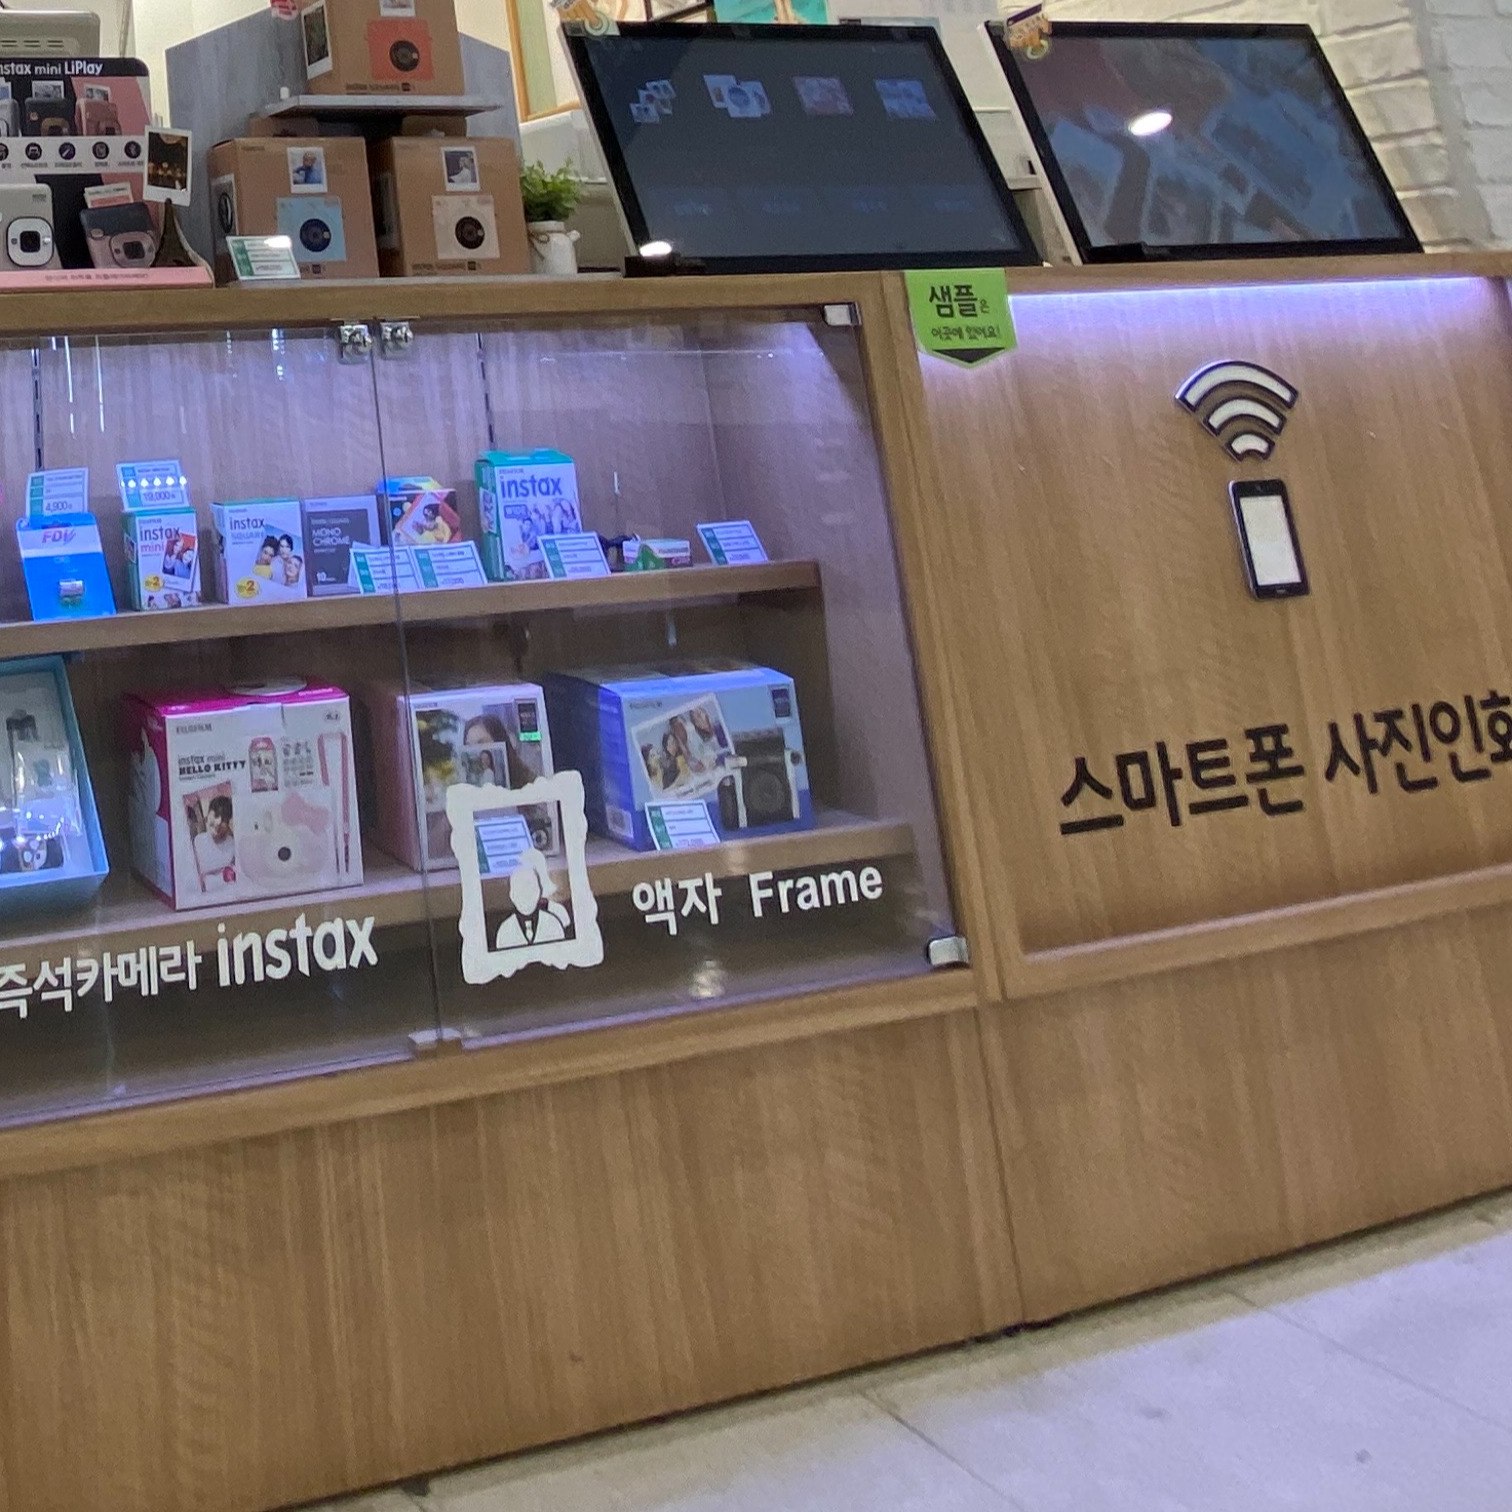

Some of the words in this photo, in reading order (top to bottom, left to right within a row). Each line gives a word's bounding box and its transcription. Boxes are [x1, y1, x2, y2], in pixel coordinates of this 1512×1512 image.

[34, 62, 62, 75] mini
[63, 61, 103, 76] LiPlay
[931, 325, 964, 341] 이곳에
[499, 475, 563, 499] instax
[229, 516, 266, 531] instax
[311, 526, 342, 537] MONO
[139, 524, 181, 542] instax
[312, 535, 351, 546] CHROME
[140, 542, 165, 553] mini
[178, 754, 205, 766] instax
[179, 763, 211, 776] HELLO
[213, 760, 247, 772] KITTY
[1059, 724, 1306, 836] 스마트폰
[1325, 690, 1512, 795] 사진인화
[631, 872, 723, 936] 액자
[748, 865, 884, 918] Frame
[217, 912, 378, 987] instax
